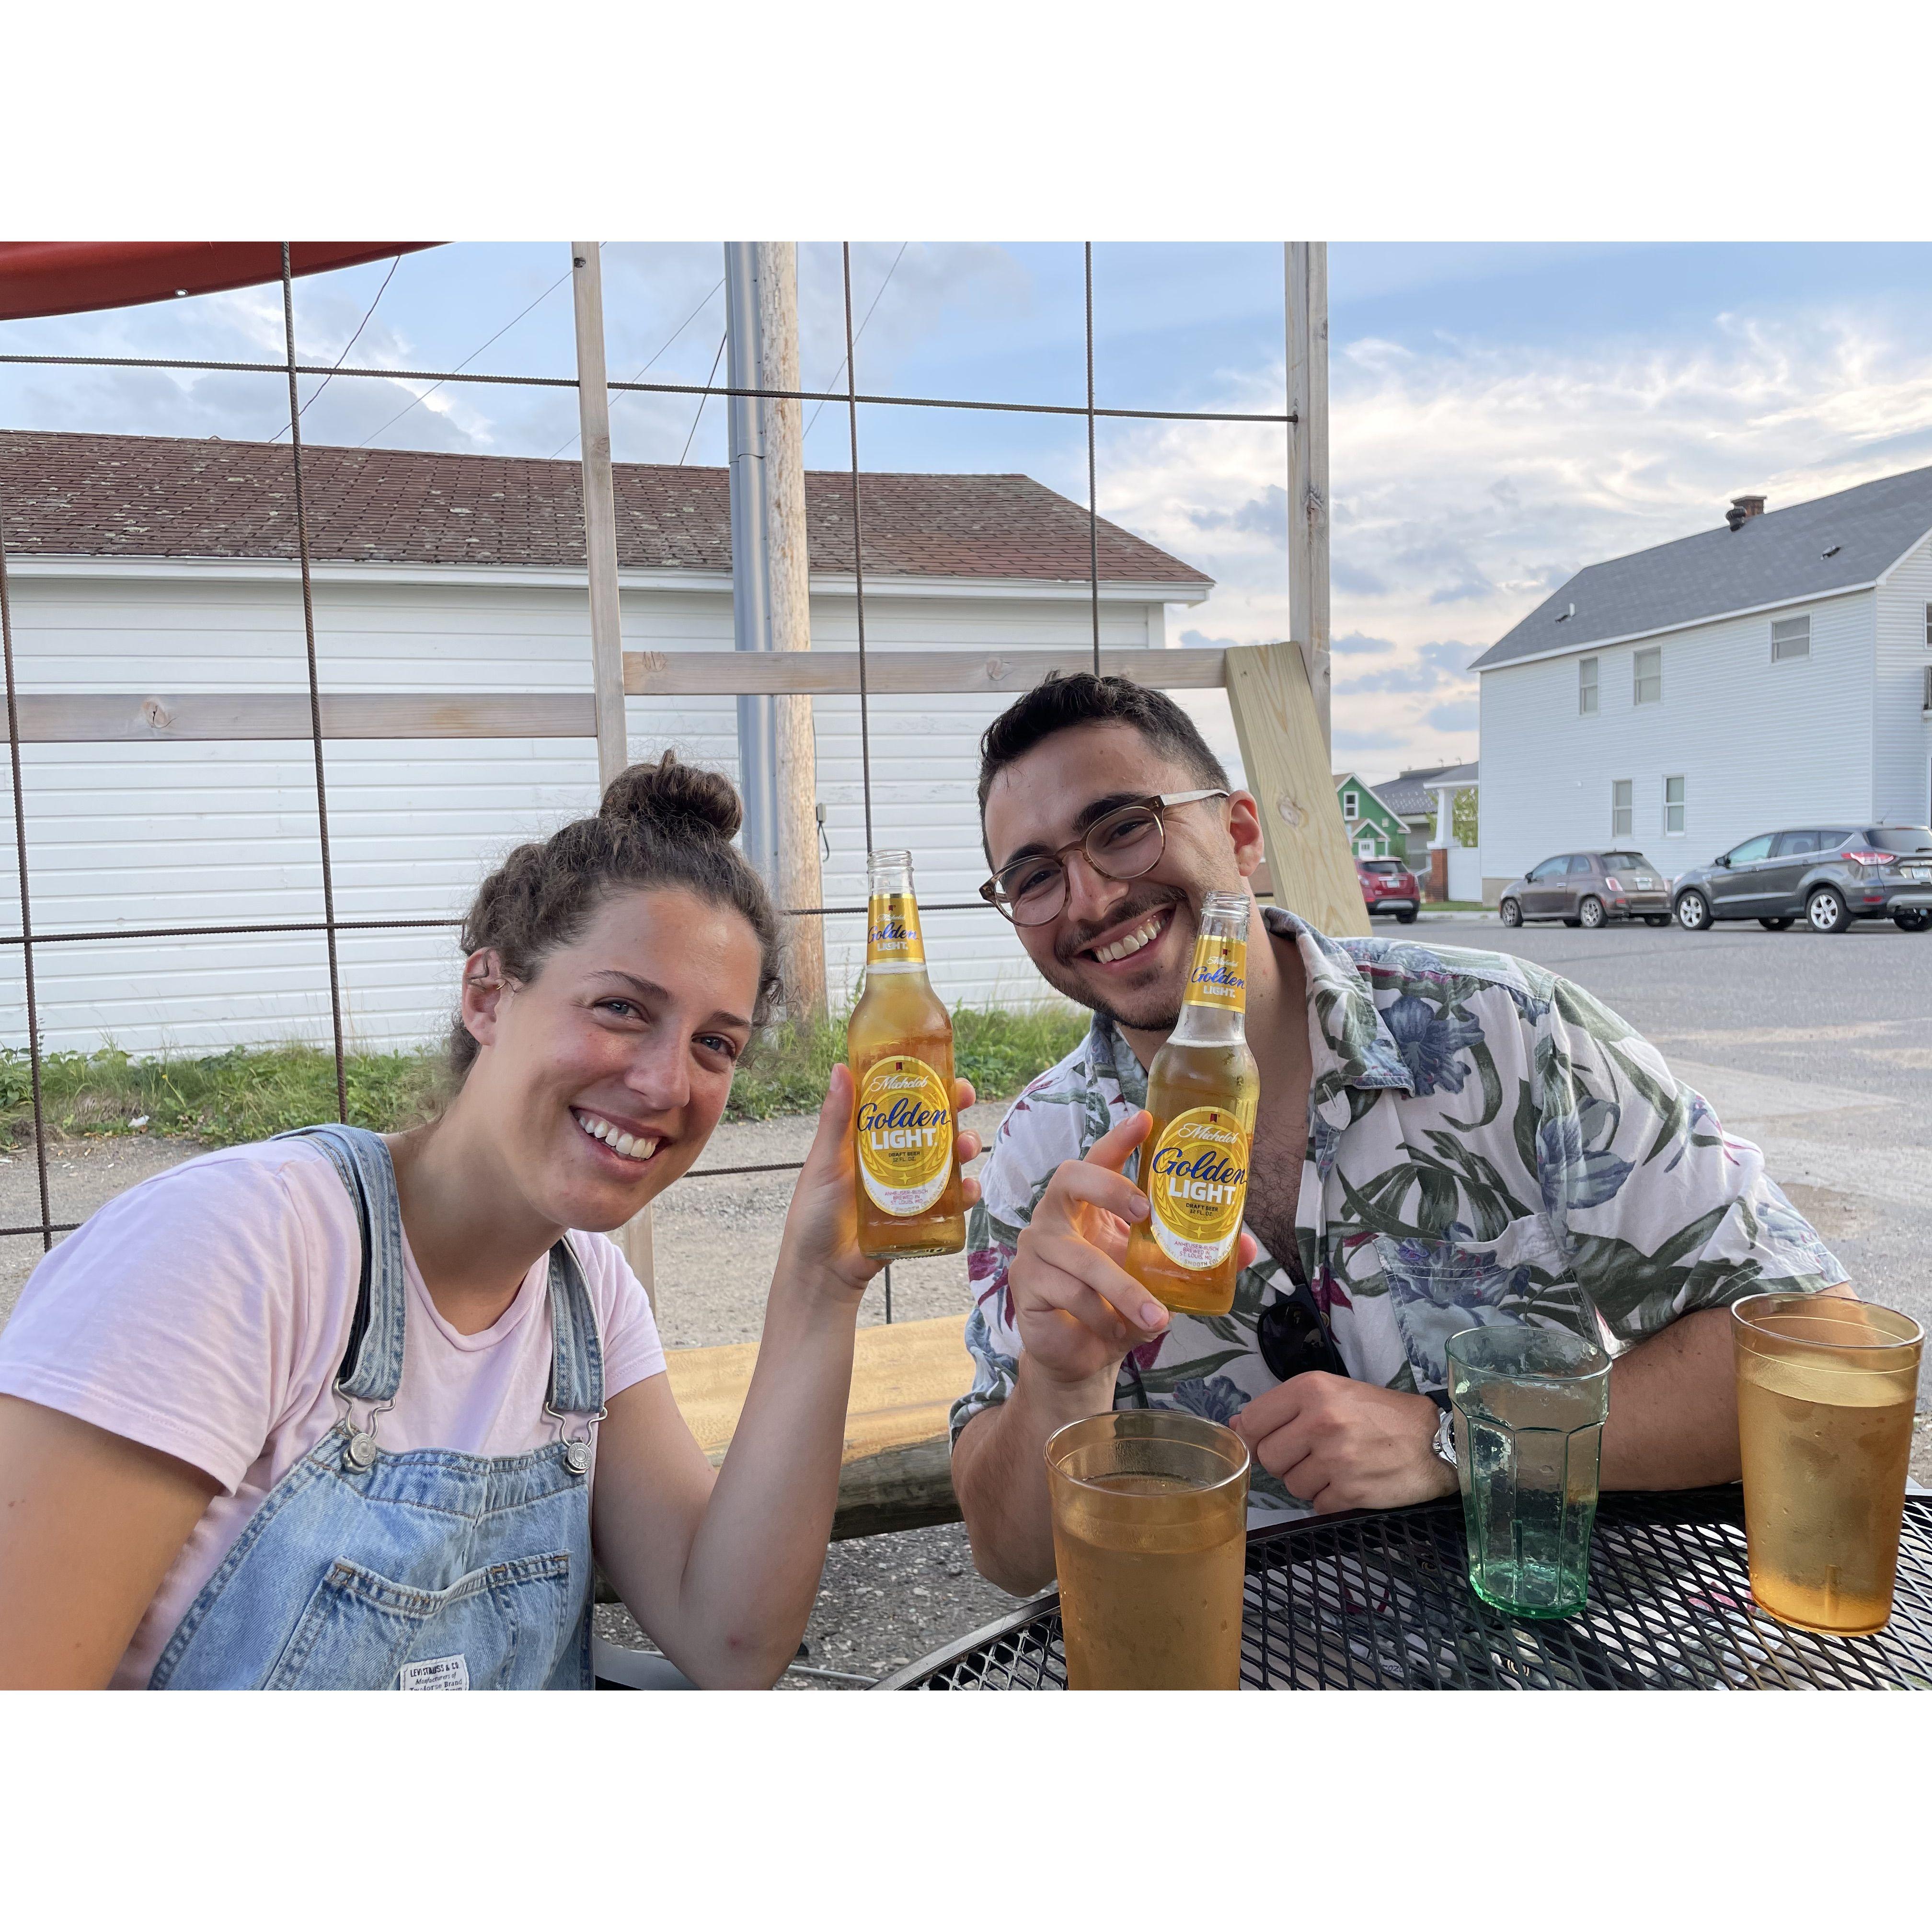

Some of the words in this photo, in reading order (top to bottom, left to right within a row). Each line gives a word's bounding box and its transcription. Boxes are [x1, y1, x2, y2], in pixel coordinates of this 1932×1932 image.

[868, 922, 919, 943] Golden
[1191, 966, 1245, 989] Golden
[870, 1074, 929, 1092] Michelob
[857, 1098, 952, 1132] Golden
[1178, 1123, 1239, 1144] Michelob
[1152, 1147, 1247, 1184] Golden
[1184, 1259, 1208, 1267] SMOOTH
[411, 1668, 422, 1677] LEVI
[444, 1679, 462, 1688] Brand
